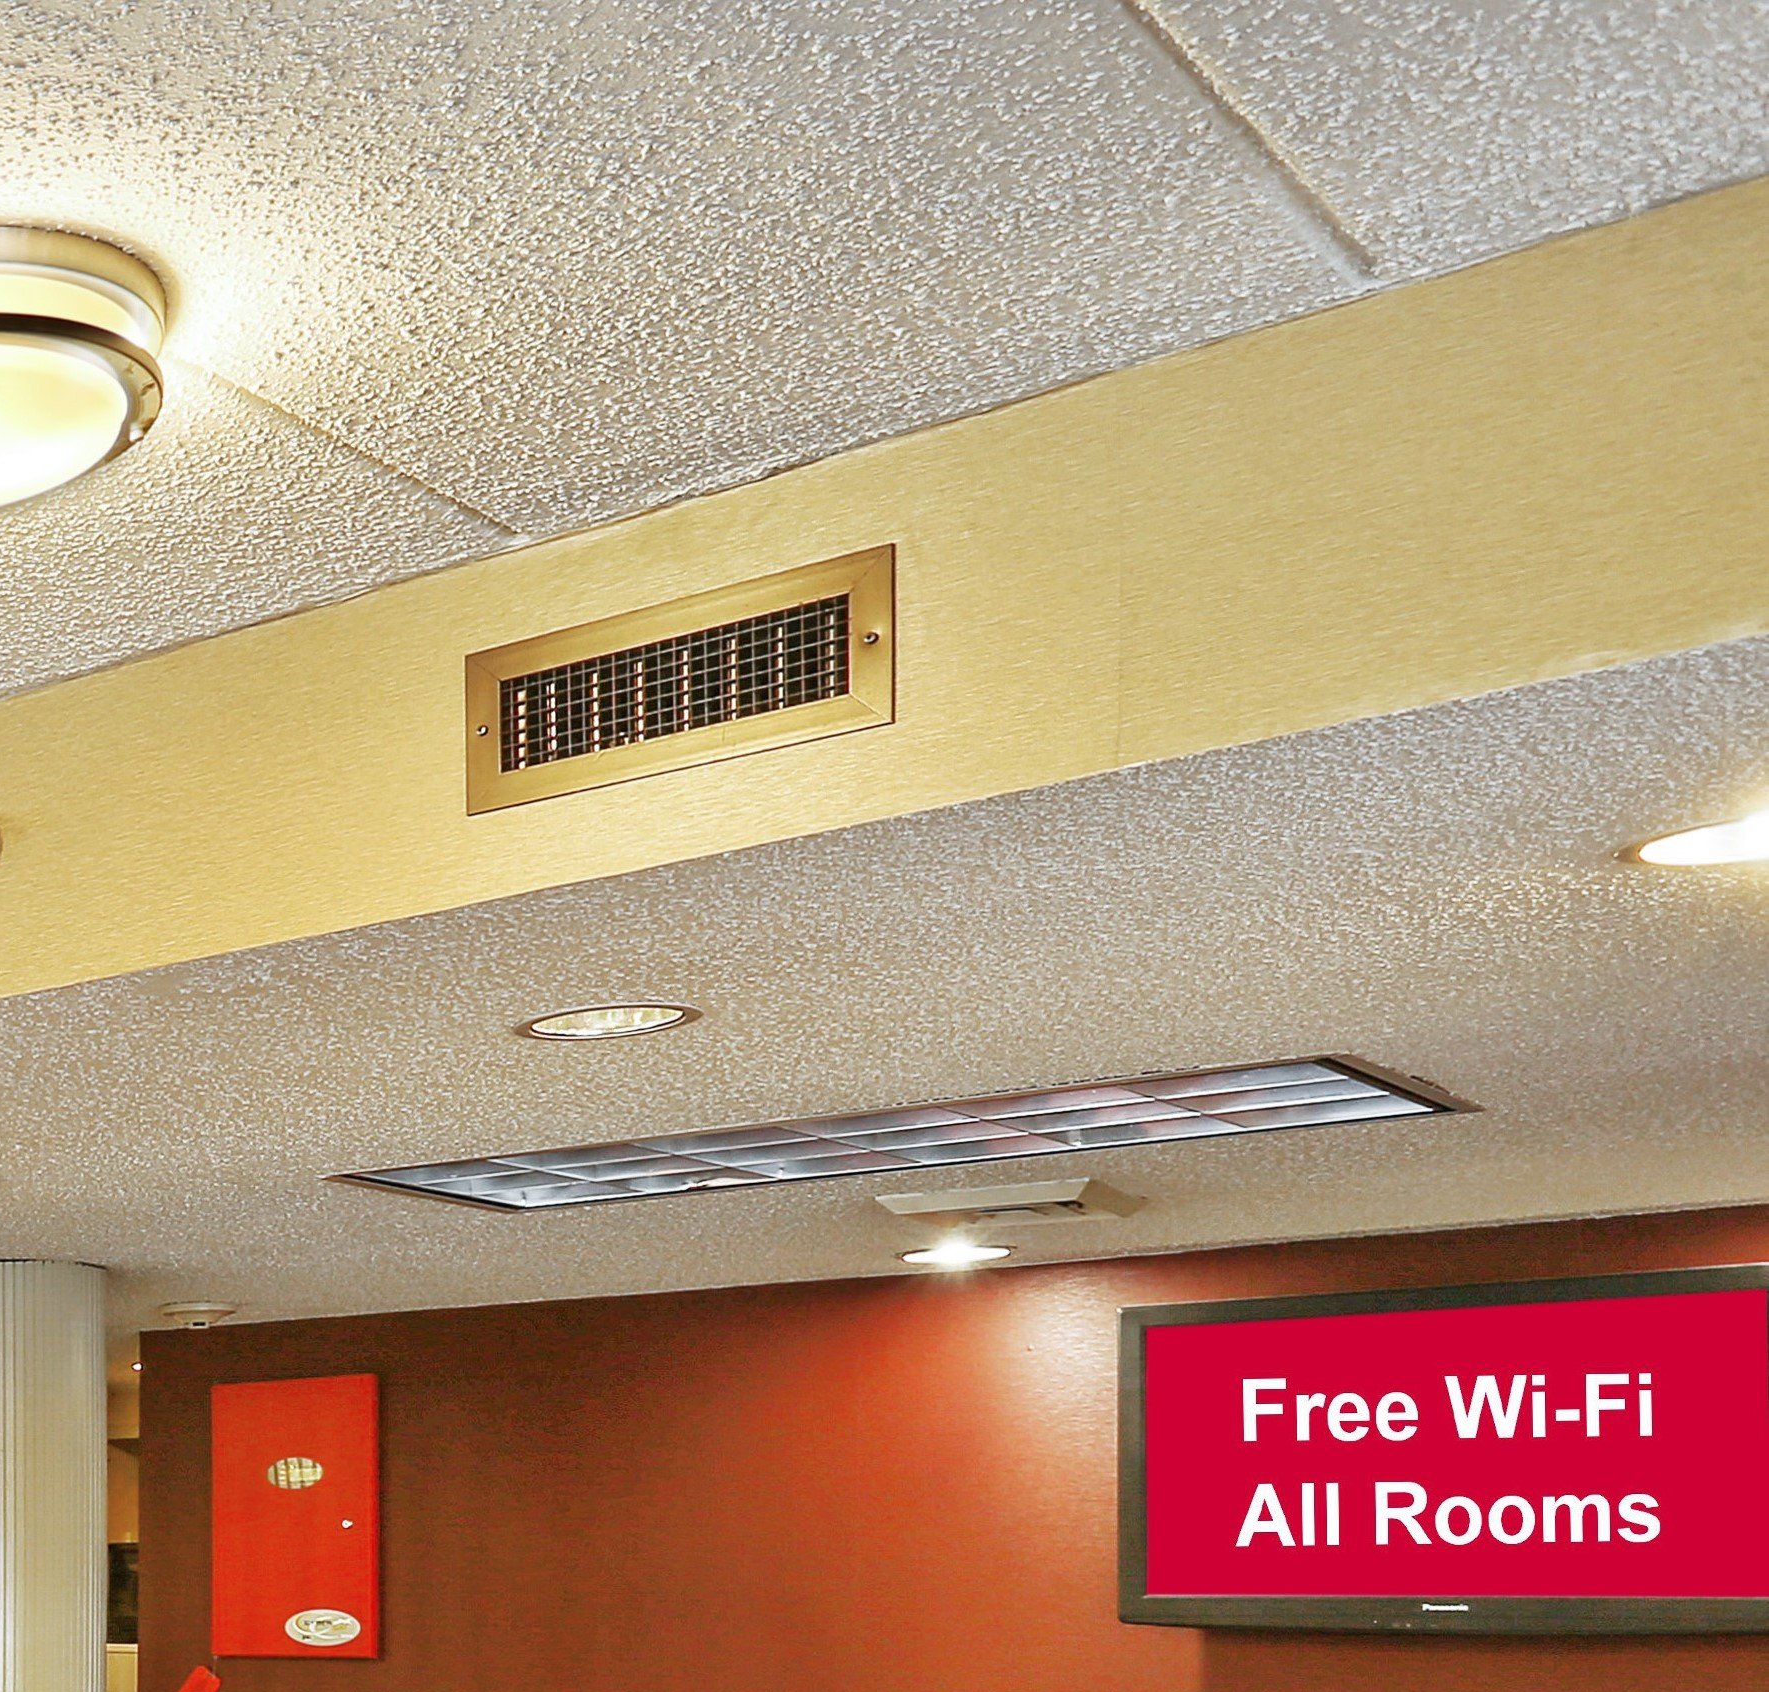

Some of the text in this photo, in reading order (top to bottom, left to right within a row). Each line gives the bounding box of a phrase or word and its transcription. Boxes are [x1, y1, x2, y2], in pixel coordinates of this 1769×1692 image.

[1242, 1372, 1654, 1442] Free Wi-Fi
[1235, 1481, 1661, 1548] All Rooms
